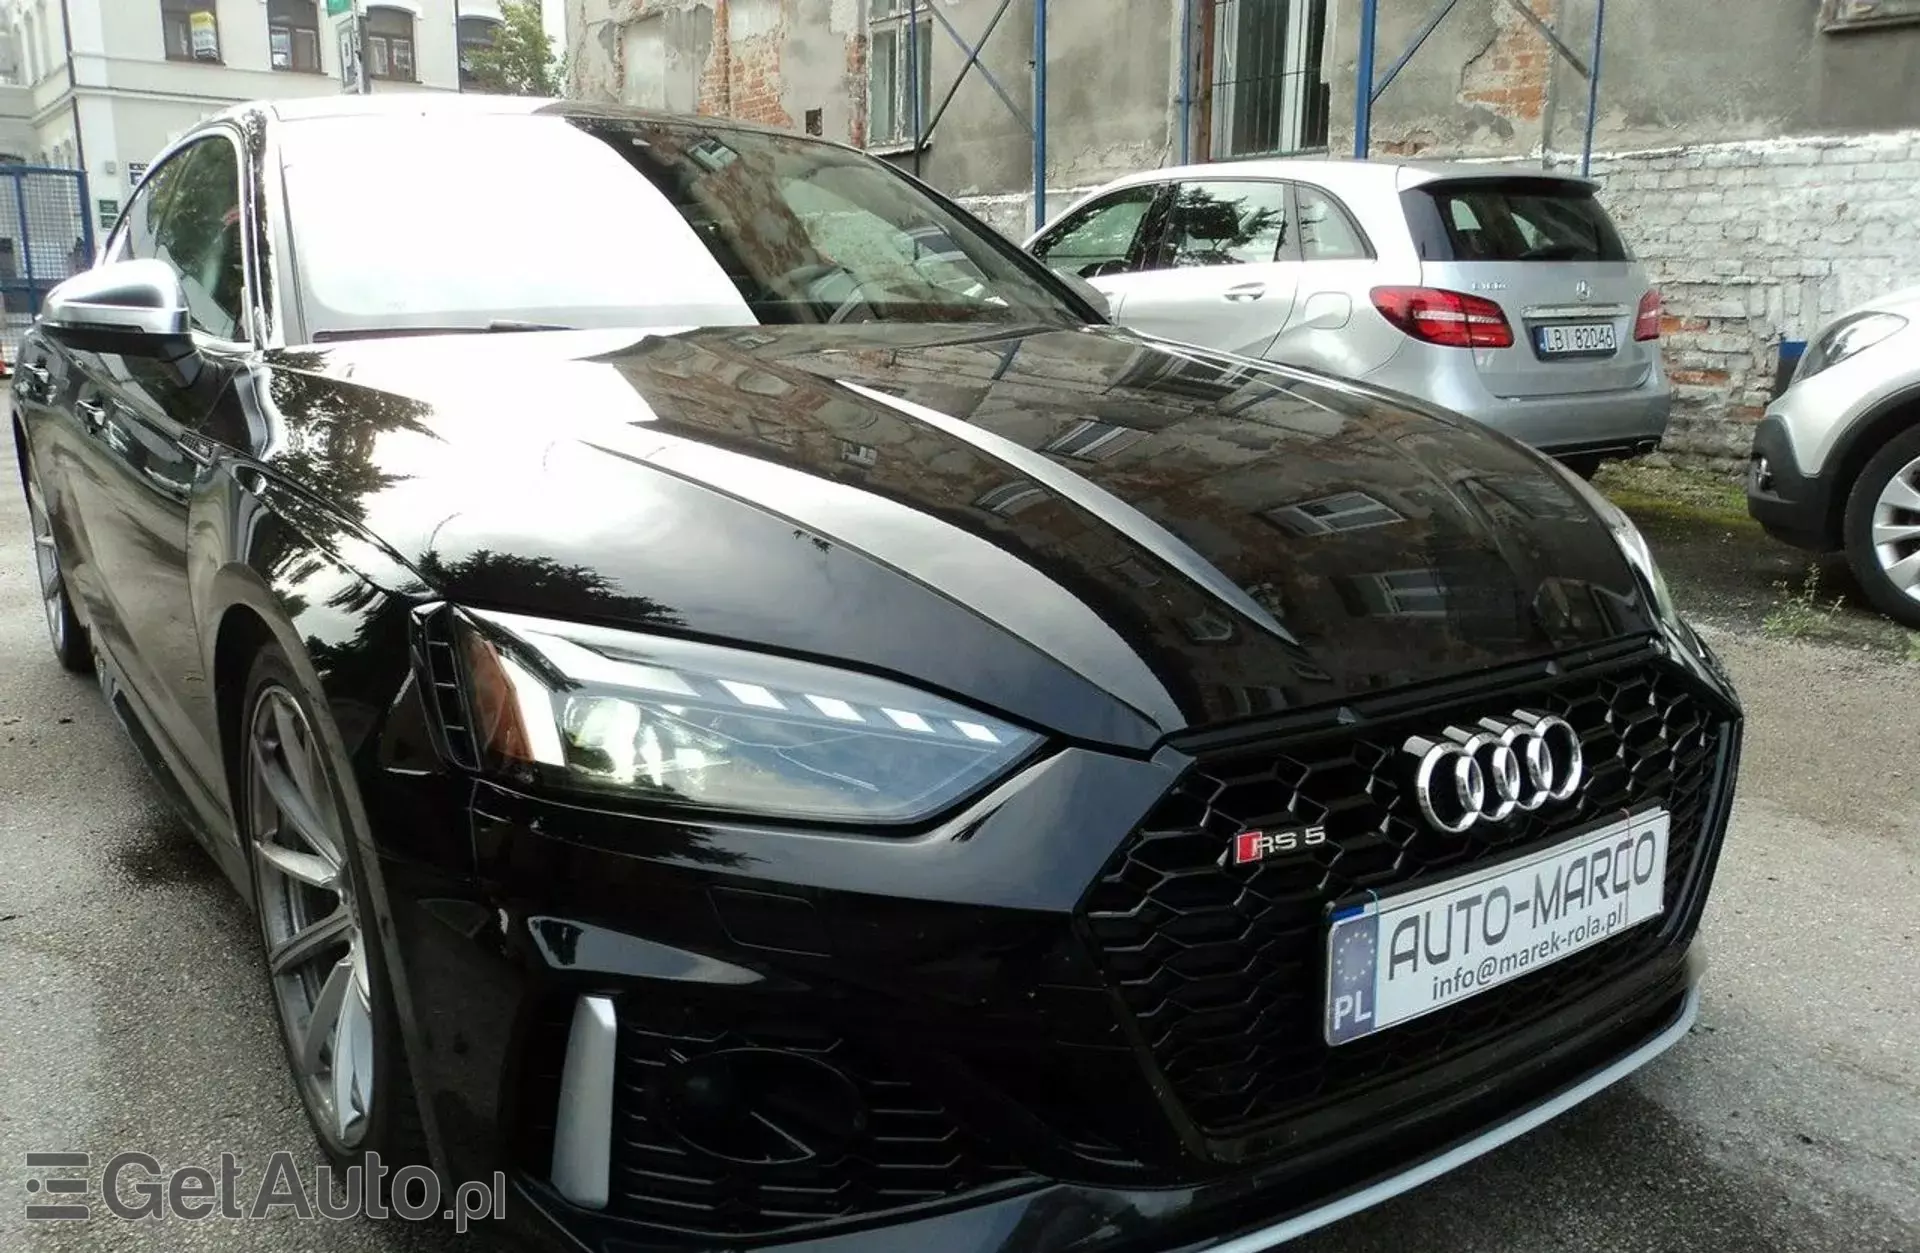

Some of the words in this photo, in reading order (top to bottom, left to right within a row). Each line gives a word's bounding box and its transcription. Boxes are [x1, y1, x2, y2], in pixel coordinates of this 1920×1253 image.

[1547, 328, 1570, 350] LBI
[1575, 327, 1613, 348] 82046
[1251, 832, 1297, 857] RS
[1305, 826, 1326, 845] 5
[1388, 830, 1656, 981] AUTO-MARCO
[1432, 902, 1623, 1000] info@marek-rola.pl
[1333, 994, 1372, 1030] PL
